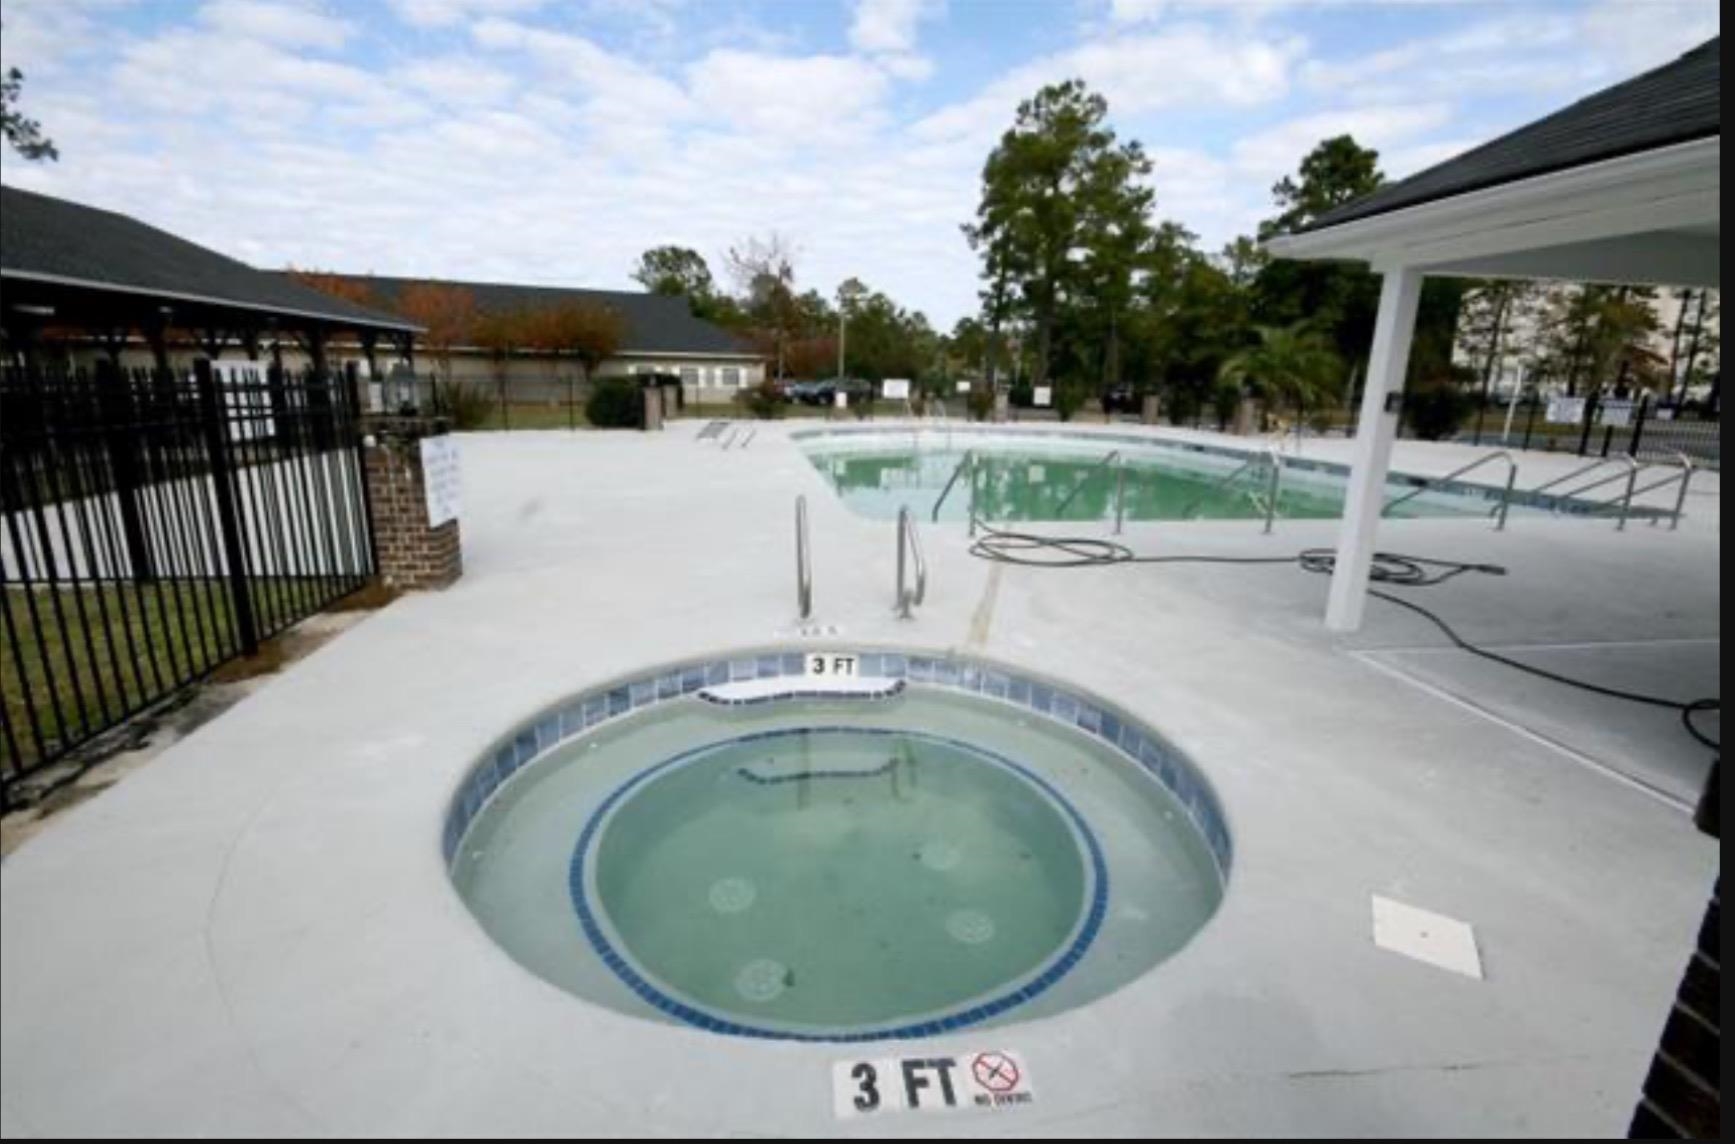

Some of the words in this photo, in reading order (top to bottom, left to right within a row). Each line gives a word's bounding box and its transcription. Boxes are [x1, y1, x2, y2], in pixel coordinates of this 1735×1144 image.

[812, 657, 826, 675] 3
[833, 657, 855, 675] FT
[850, 1062, 880, 1112] 3
[901, 1057, 956, 1108] FT
